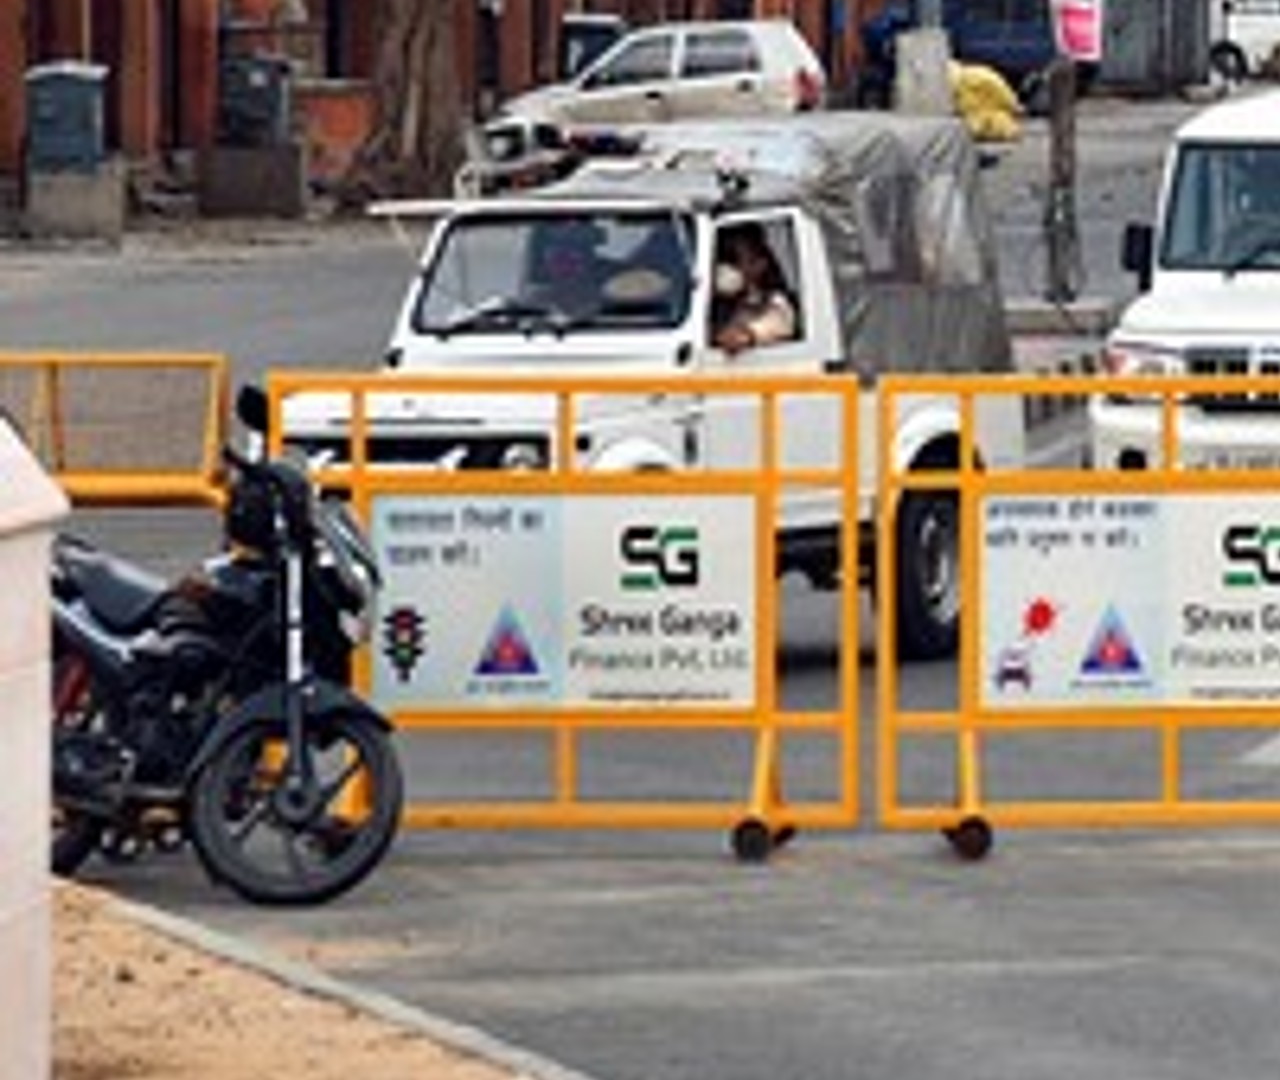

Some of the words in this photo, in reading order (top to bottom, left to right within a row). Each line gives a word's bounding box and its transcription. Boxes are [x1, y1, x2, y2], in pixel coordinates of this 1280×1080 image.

[620, 526, 699, 590] SG
[579, 604, 653, 636] Shree
[658, 604, 740, 642] Ganga
[1181, 603, 1255, 635] Shree
[569, 648, 654, 672] Finance
[1170, 646, 1255, 671] Finance
